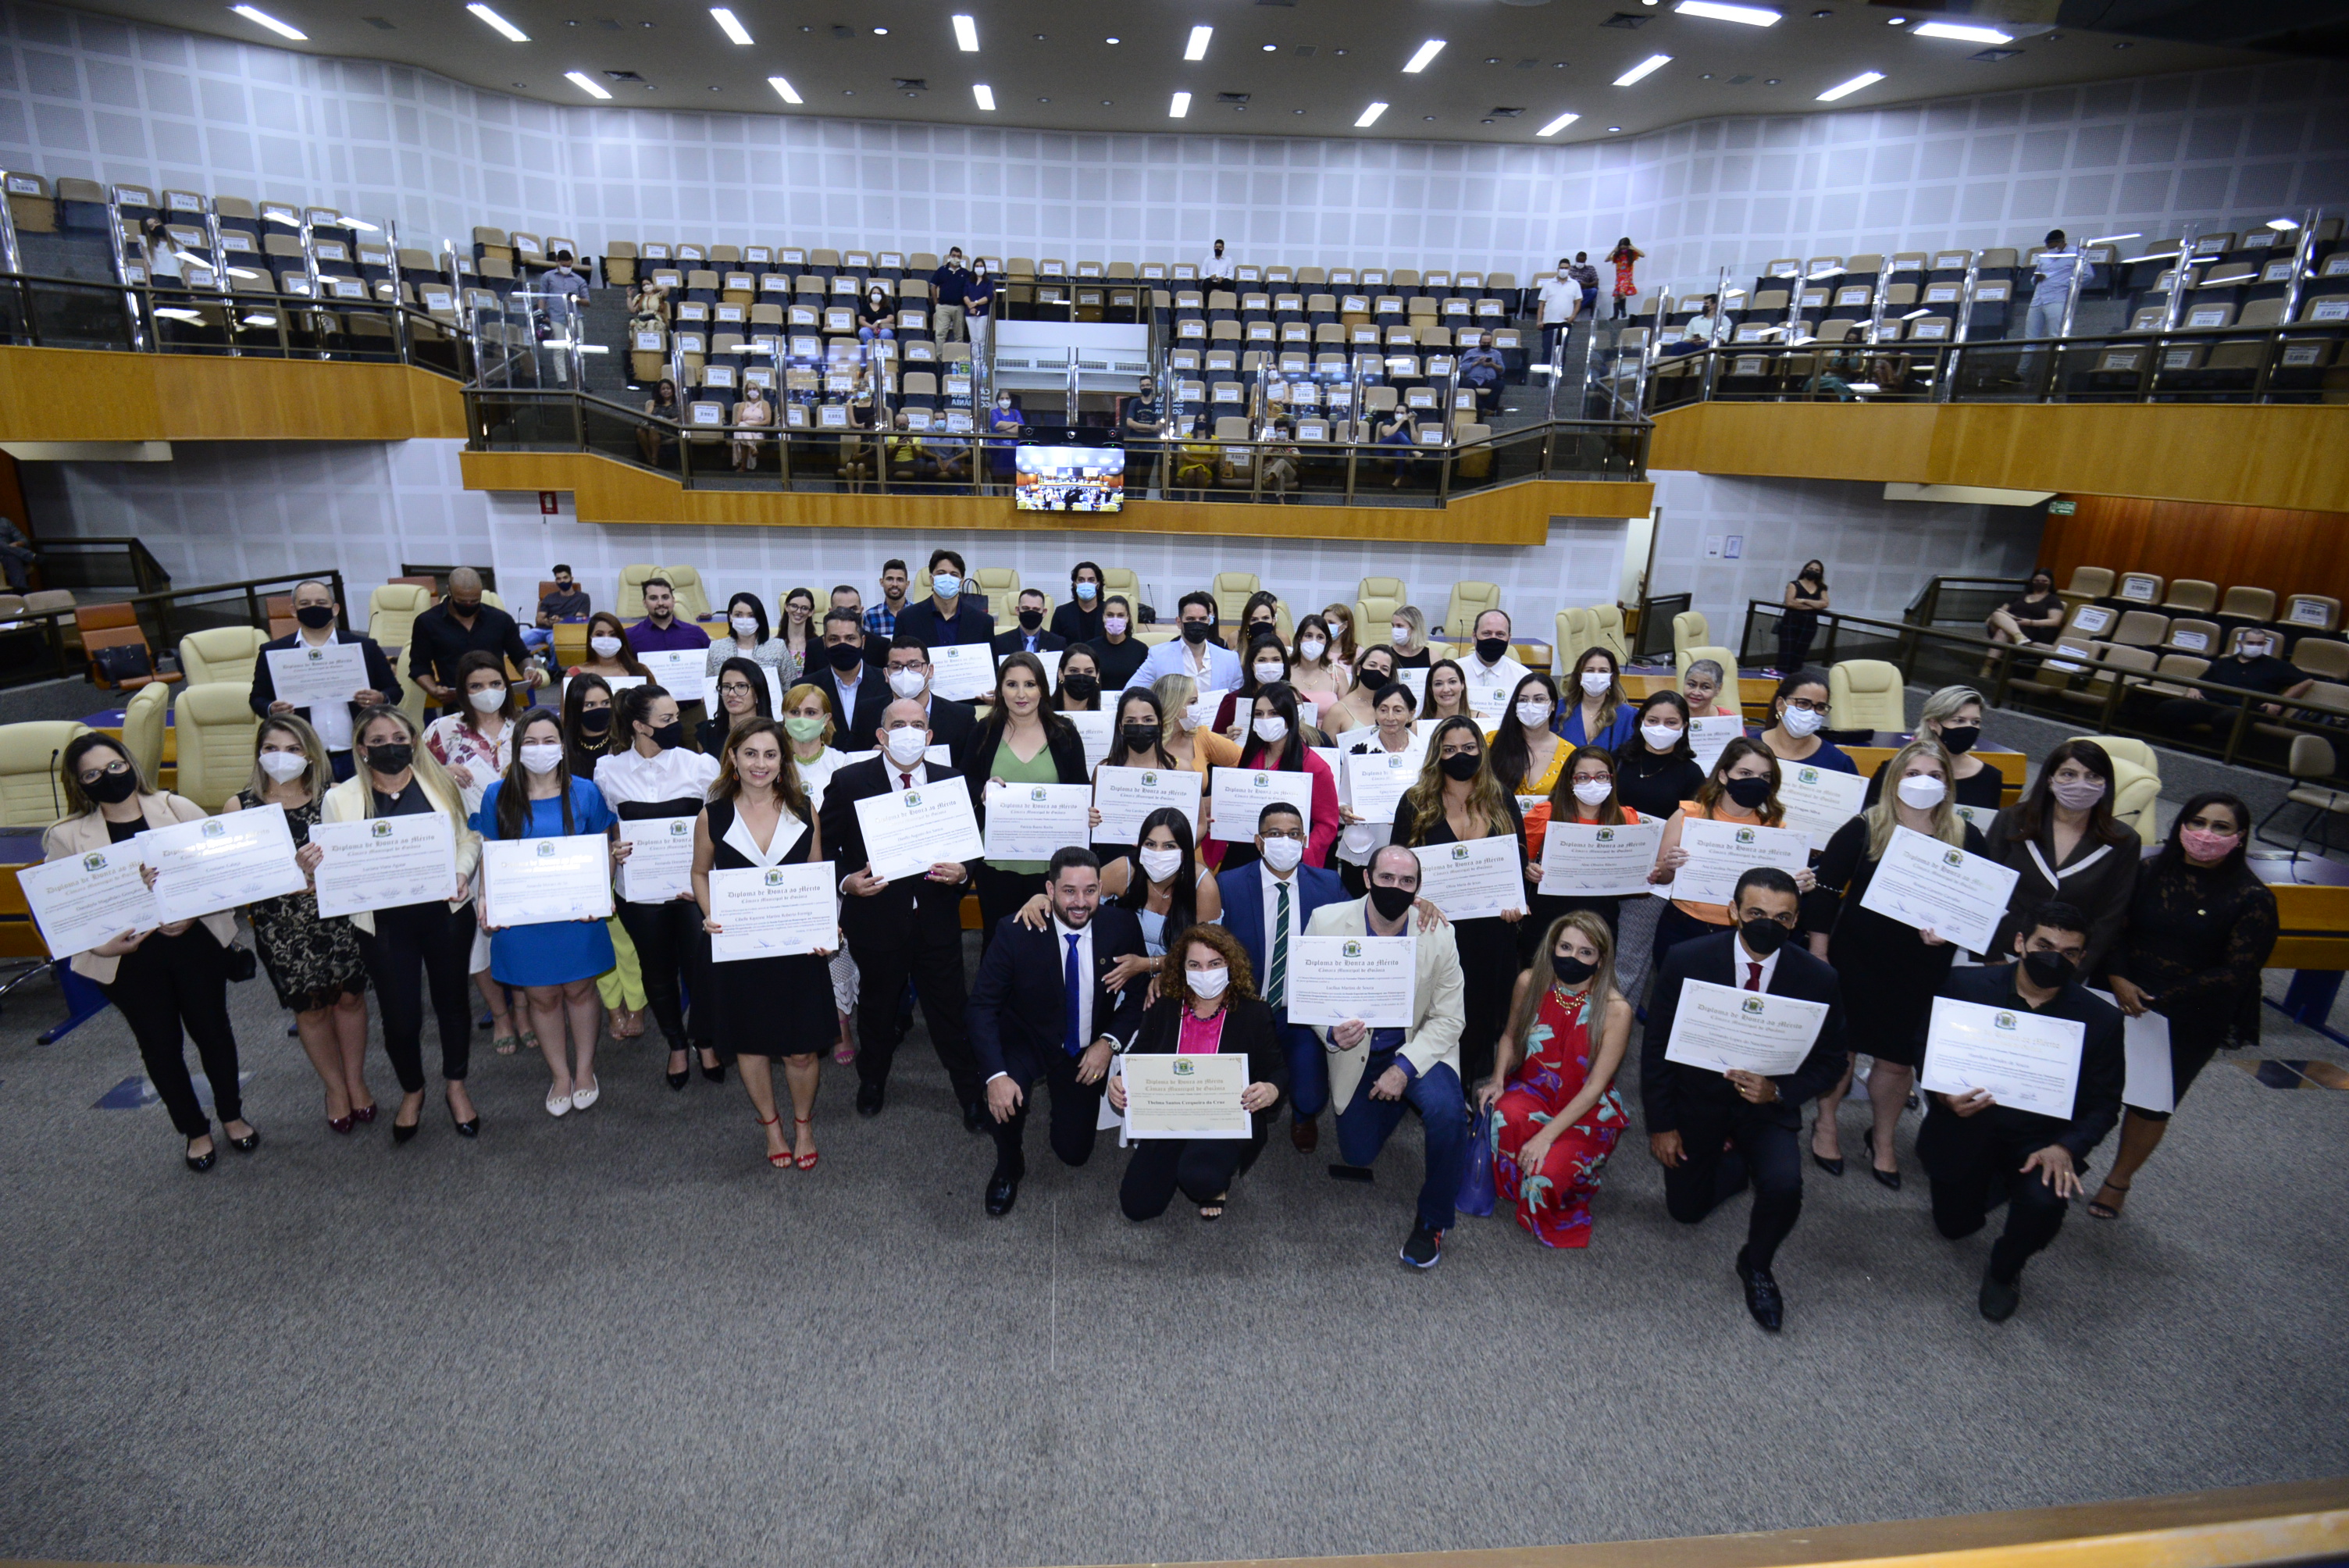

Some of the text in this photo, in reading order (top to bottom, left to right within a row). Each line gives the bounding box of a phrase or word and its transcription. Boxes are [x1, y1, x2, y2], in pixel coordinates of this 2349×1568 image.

[875, 813, 900, 824] Diploma
[909, 807, 927, 816] Honra
[937, 800, 956, 810] Mérito
[332, 843, 363, 852] Diploma
[376, 839, 398, 847] Honra
[411, 835, 435, 844] Mérito
[1697, 839, 1724, 848] Diploma
[1736, 844, 1757, 852] Honra
[1768, 848, 1791, 857] Mérito
[46, 879, 79, 894] Diploma
[1698, 1004, 1728, 1016] Diploma
[1741, 1014, 1764, 1024] Honra
[1777, 1020, 1802, 1029] Mérito
